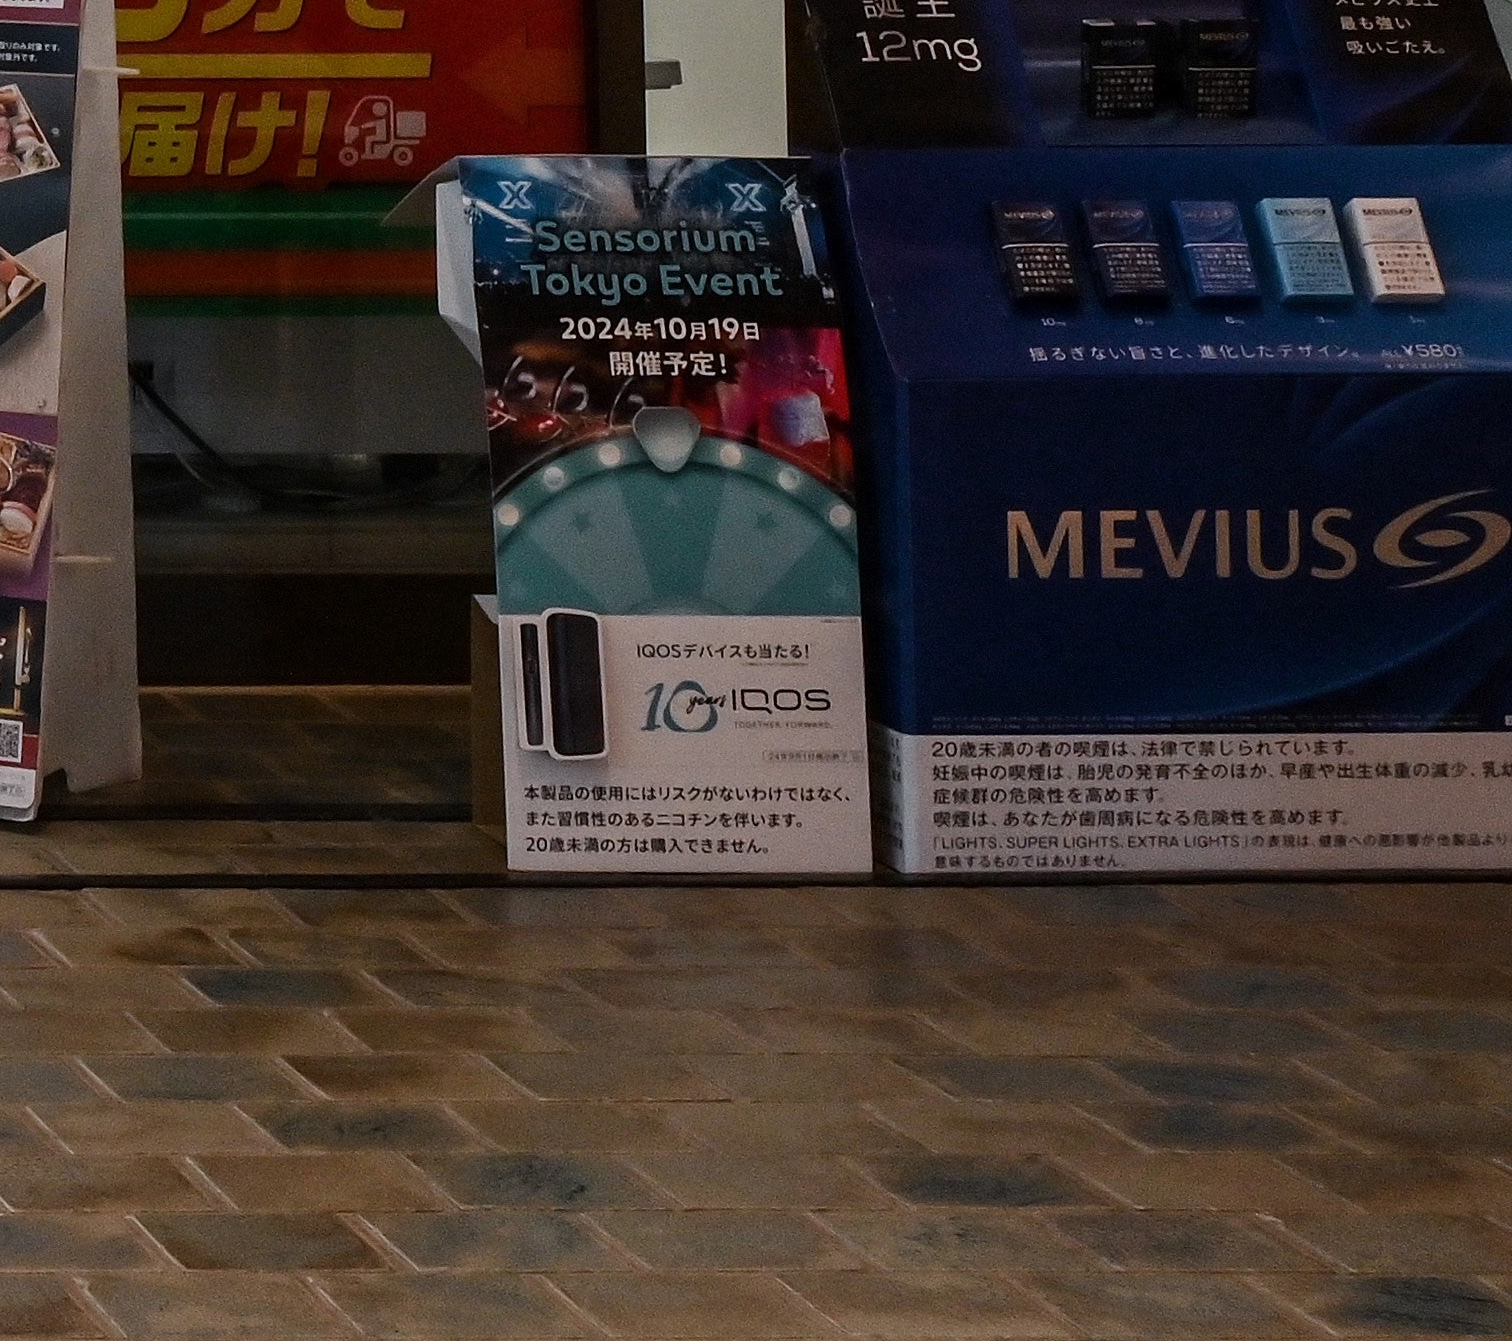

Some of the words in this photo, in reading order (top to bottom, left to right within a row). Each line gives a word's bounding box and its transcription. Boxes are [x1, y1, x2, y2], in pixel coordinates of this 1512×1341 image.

[1339, 15, 1412, 31] 最も強い
[855, 30, 983, 71] 12mg
[536, 221, 758, 253] Sensorium
[521, 264, 647, 305] Tokyo
[661, 264, 784, 298] Event
[559, 317, 760, 341] 2024年10月19日
[609, 350, 728, 377] 開催予定!
[1007, 508, 1359, 581] MEVIUS
[636, 643, 810, 659] IQOSデバイスも当たる!
[731, 687, 832, 715] IQOS
[525, 836, 769, 855] 20歳未満の方は購入できません。
[1006, 836, 1059, 849] SUPER
